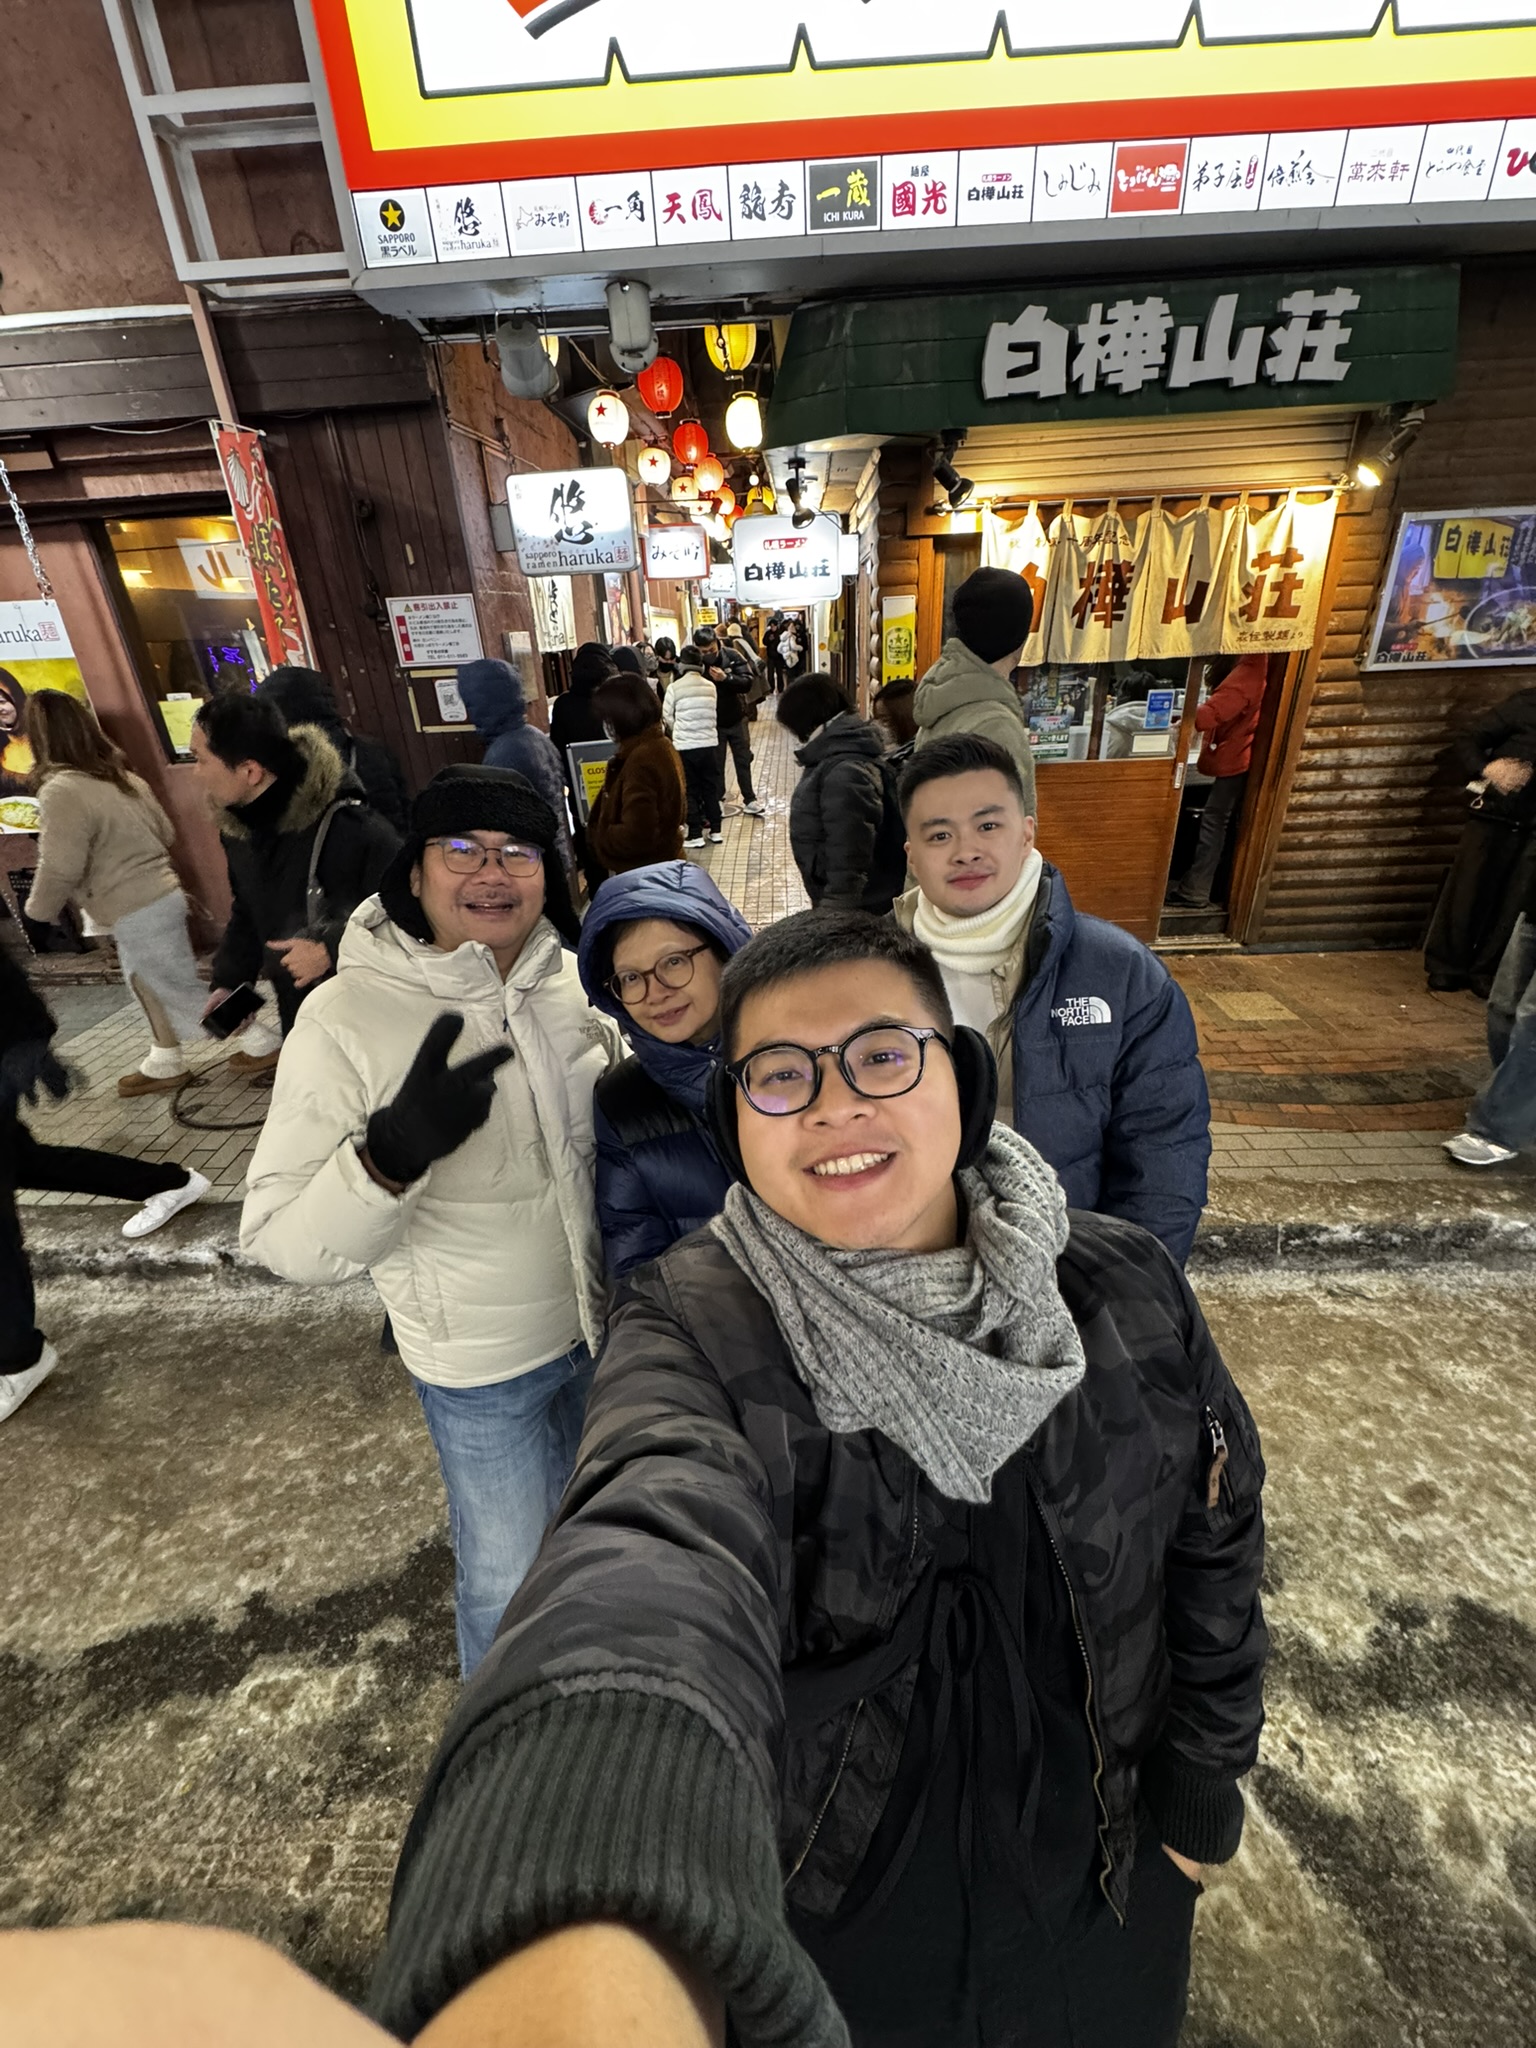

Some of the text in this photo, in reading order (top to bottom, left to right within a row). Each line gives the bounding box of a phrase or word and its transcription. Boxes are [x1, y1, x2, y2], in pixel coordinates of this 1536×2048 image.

[816, 168, 871, 208] 一蔵
[967, 184, 1024, 201] 白樺山荘
[662, 188, 723, 224] 天鳳
[454, 197, 482, 236] 悠
[823, 210, 865, 223] ICHI KURA
[378, 232, 416, 244] SAPPORO
[461, 239, 492, 250] haruka
[380, 244, 418, 258] 黒ラベル
[982, 286, 1361, 400] 白樺山荘
[550, 479, 597, 545] 悠
[525, 551, 558, 561] sapporo
[559, 548, 615, 567] haruka
[526, 561, 558, 570] ramen
[744, 559, 831, 581] 白樺山荘
[1065, 996, 1089, 1007] THE
[1051, 1006, 1089, 1018] NORTH
[1061, 1016, 1090, 1026] FACE
